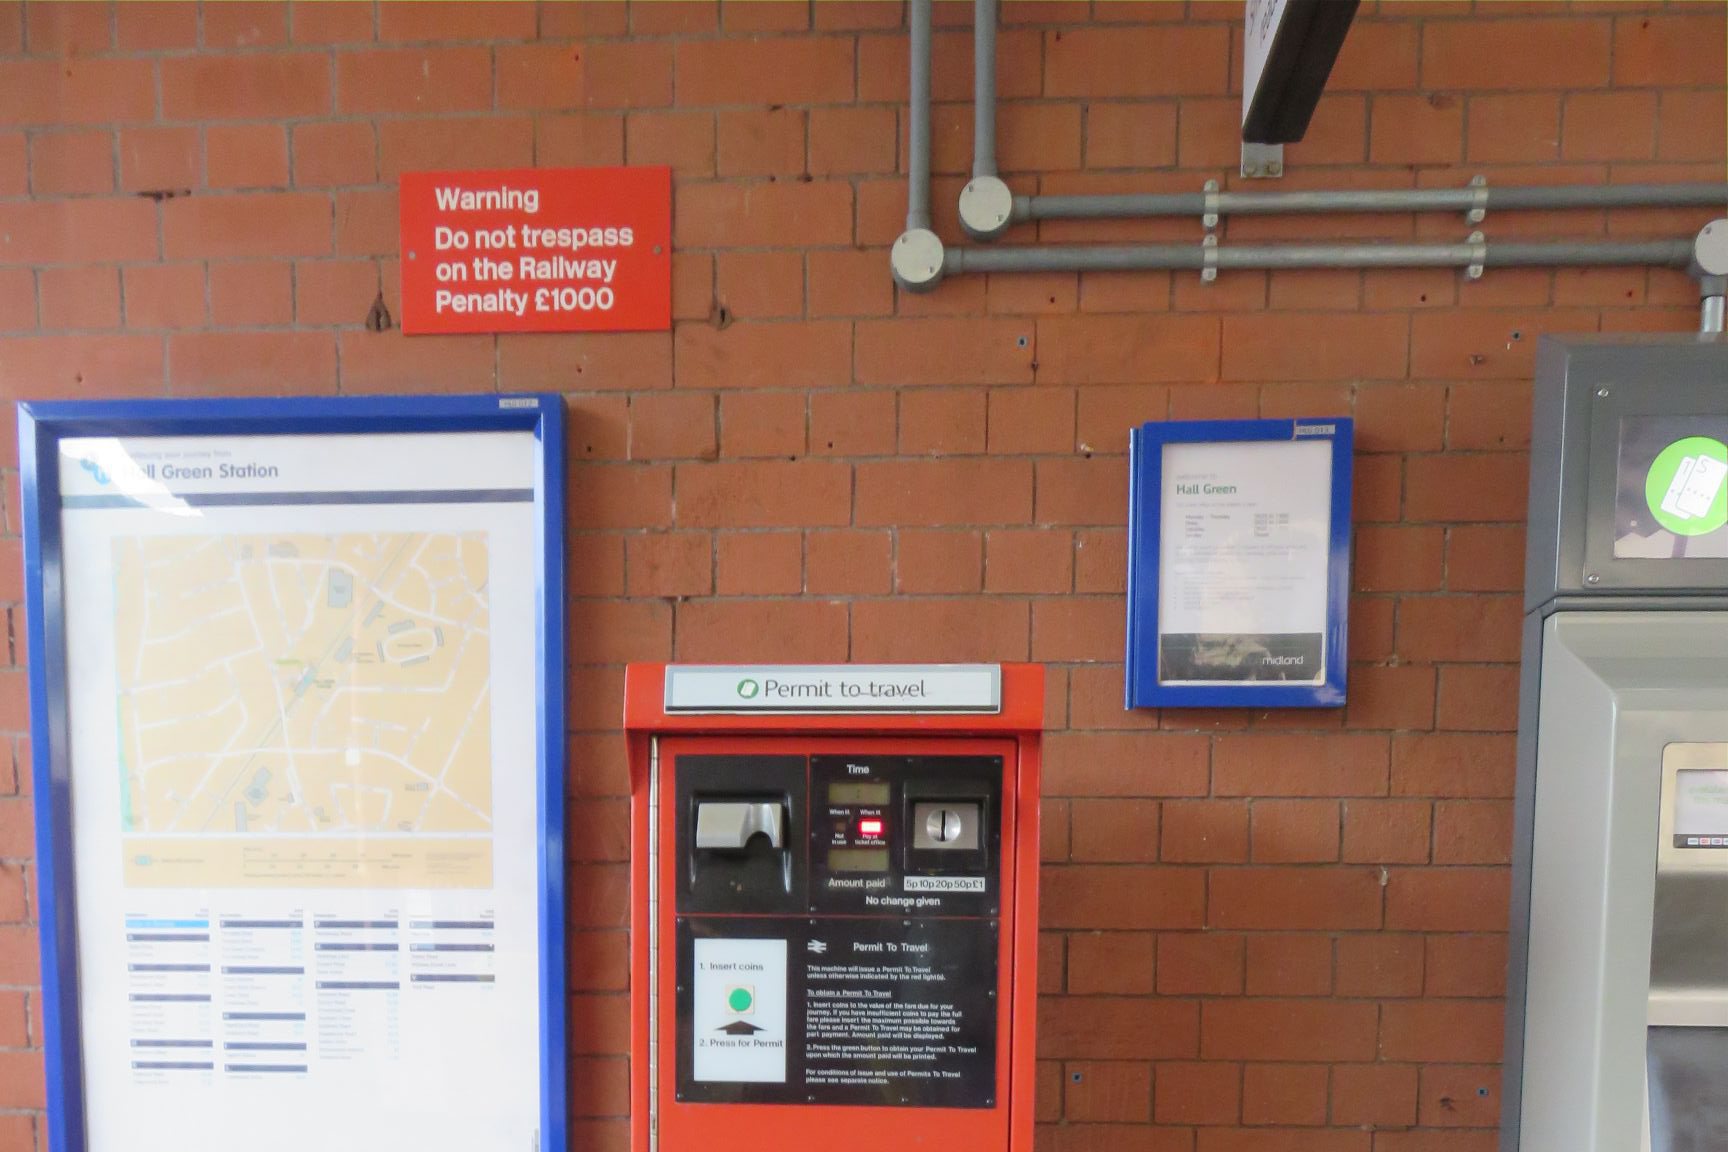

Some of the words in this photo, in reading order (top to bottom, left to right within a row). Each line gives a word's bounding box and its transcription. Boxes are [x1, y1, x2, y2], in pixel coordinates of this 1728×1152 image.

[435, 186, 539, 213] Warning
[435, 227, 469, 249] Do
[475, 224, 516, 249] not
[521, 224, 634, 252] trespass
[435, 260, 467, 282] on
[472, 256, 513, 281] the
[519, 255, 616, 283] Railway
[436, 288, 528, 316] Penalty
[535, 287, 614, 312] £1000
[161, 464, 213, 480] Green
[218, 462, 279, 480] Station
[1176, 484, 1200, 495] Hall
[1203, 483, 1237, 495] Green
[1262, 655, 1305, 666] midland
[764, 679, 832, 698] Permit
[839, 680, 861, 698] to
[869, 679, 927, 698] travel
[846, 764, 870, 775] Time
[860, 808, 874, 816] When
[828, 878, 863, 888] Amount
[866, 878, 886, 889] paid
[905, 880, 918, 890] 5p
[920, 880, 935, 890] 10p
[935, 880, 953, 890] 20p
[954, 880, 972, 890] 50p
[972, 880, 984, 889] £1
[866, 896, 879, 905] No
[881, 896, 915, 907] change
[916, 896, 941, 908] given
[853, 942, 883, 952] Permit
[886, 942, 898, 952] To
[901, 942, 928, 952] Travel
[738, 963, 764, 971] coins
[821, 965, 847, 973] machine
[828, 972, 859, 980] otherwise
[889, 973, 898, 981] by
[807, 989, 815, 997] To
[815, 989, 836, 997] obtain
[842, 989, 863, 997] Permit
[872, 990, 892, 998] Travel
[710, 1039, 736, 1047] Press
[738, 1039, 751, 1047] for
[753, 1039, 783, 1048] Permit
